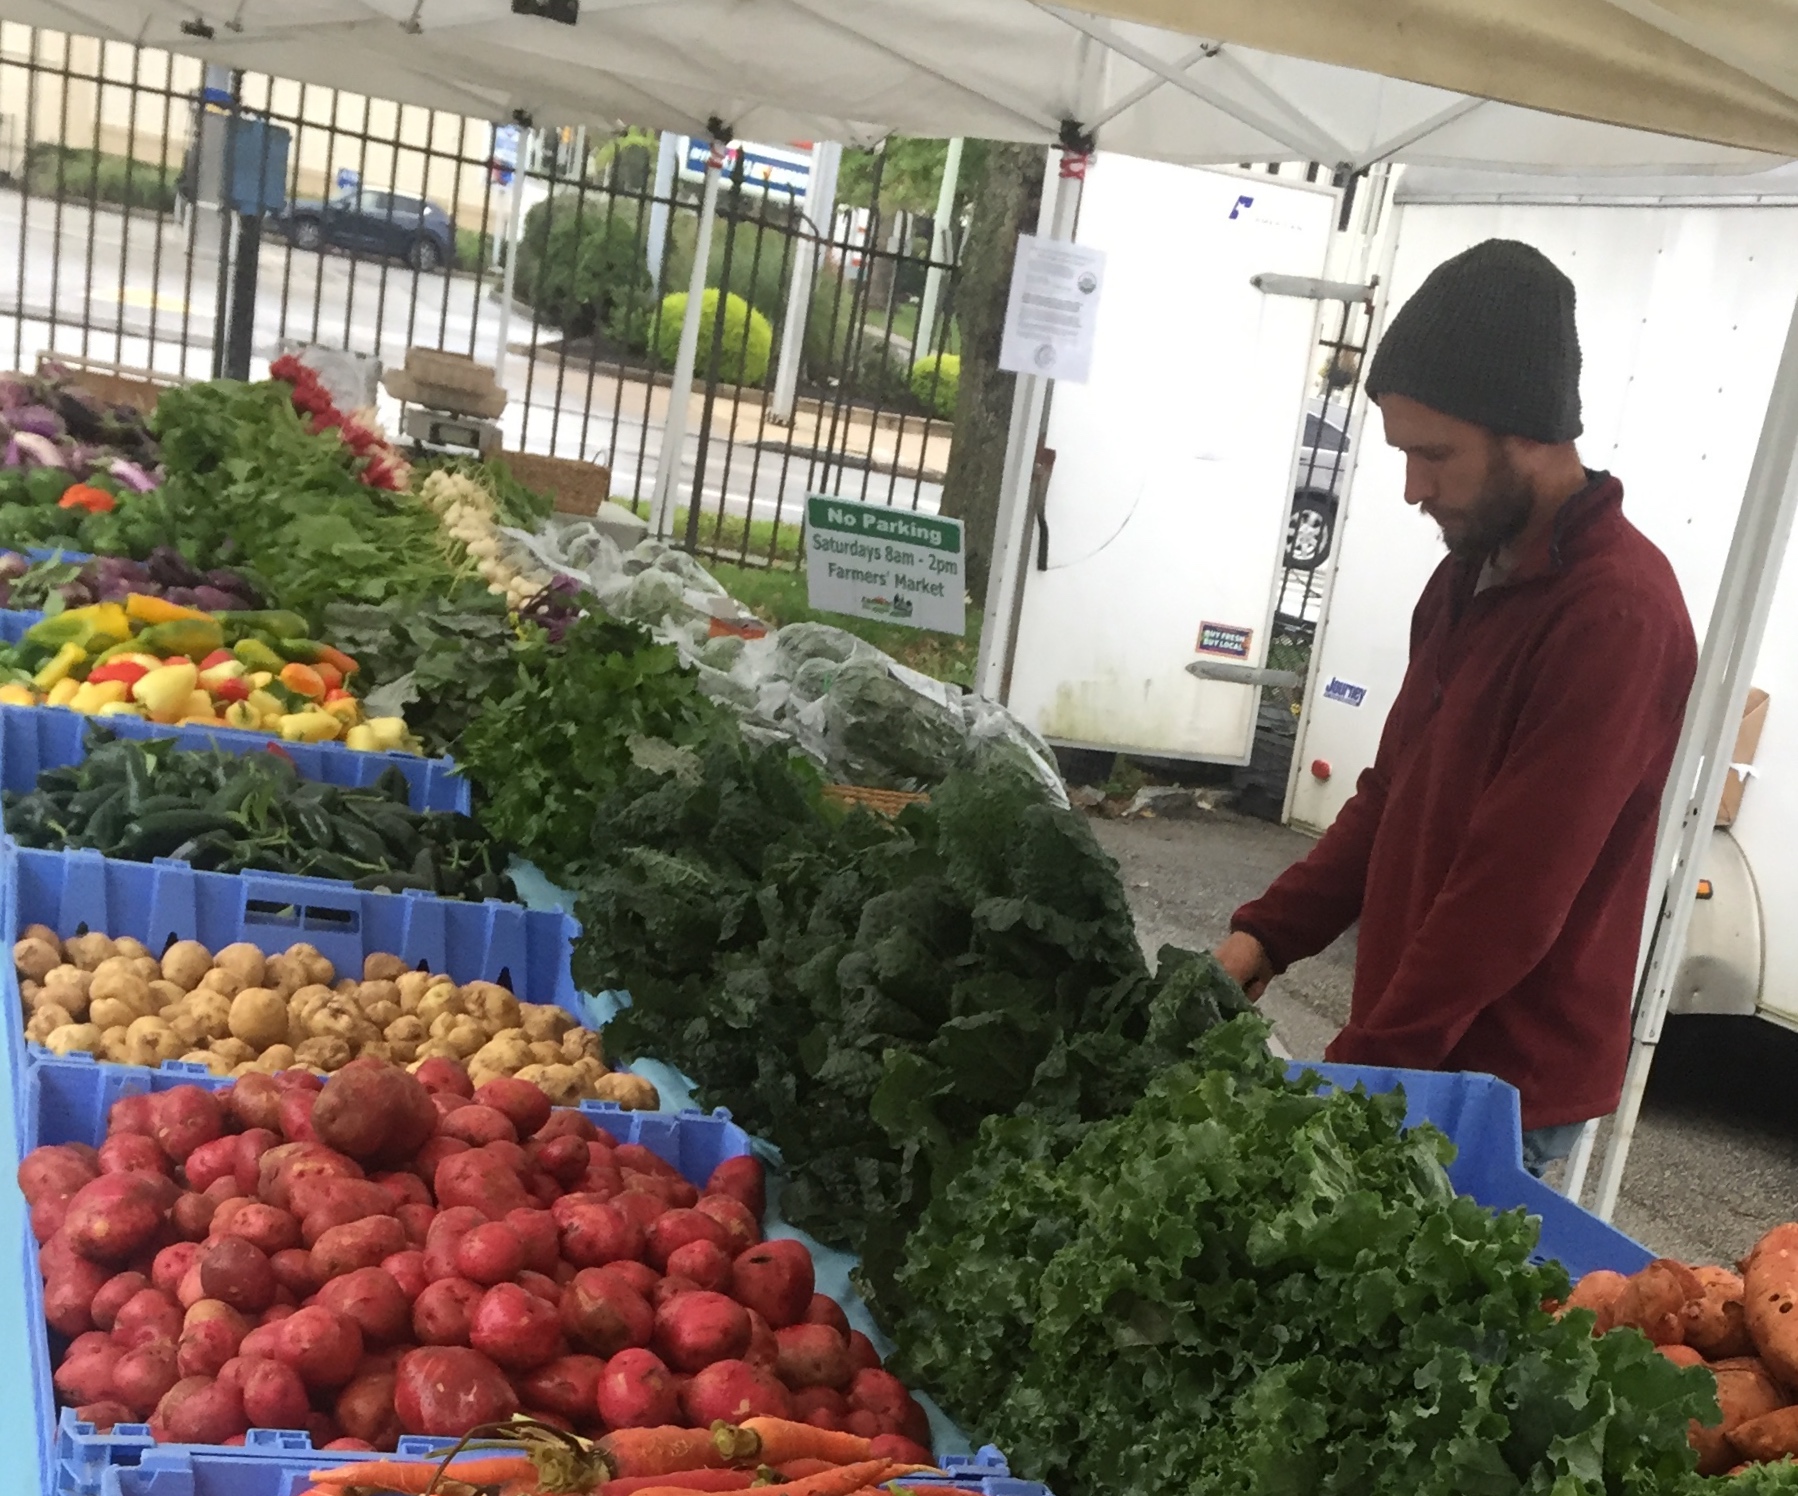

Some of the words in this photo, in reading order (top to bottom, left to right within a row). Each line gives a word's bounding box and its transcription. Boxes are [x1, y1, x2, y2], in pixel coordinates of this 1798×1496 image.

[828, 507, 857, 527] No
[863, 513, 942, 545] Parking
[812, 533, 881, 563] Saturdays
[885, 546, 914, 566] 8am
[928, 554, 958, 576] 2pm
[828, 562, 890, 586] Farmers'
[894, 574, 945, 597] Market
[1203, 638, 1220, 646] BUY
[1219, 641, 1243, 651] LOCAL
[1204, 629, 1220, 639] BUY
[1220, 632, 1245, 642] FRESH
[1325, 677, 1367, 706] Journey
